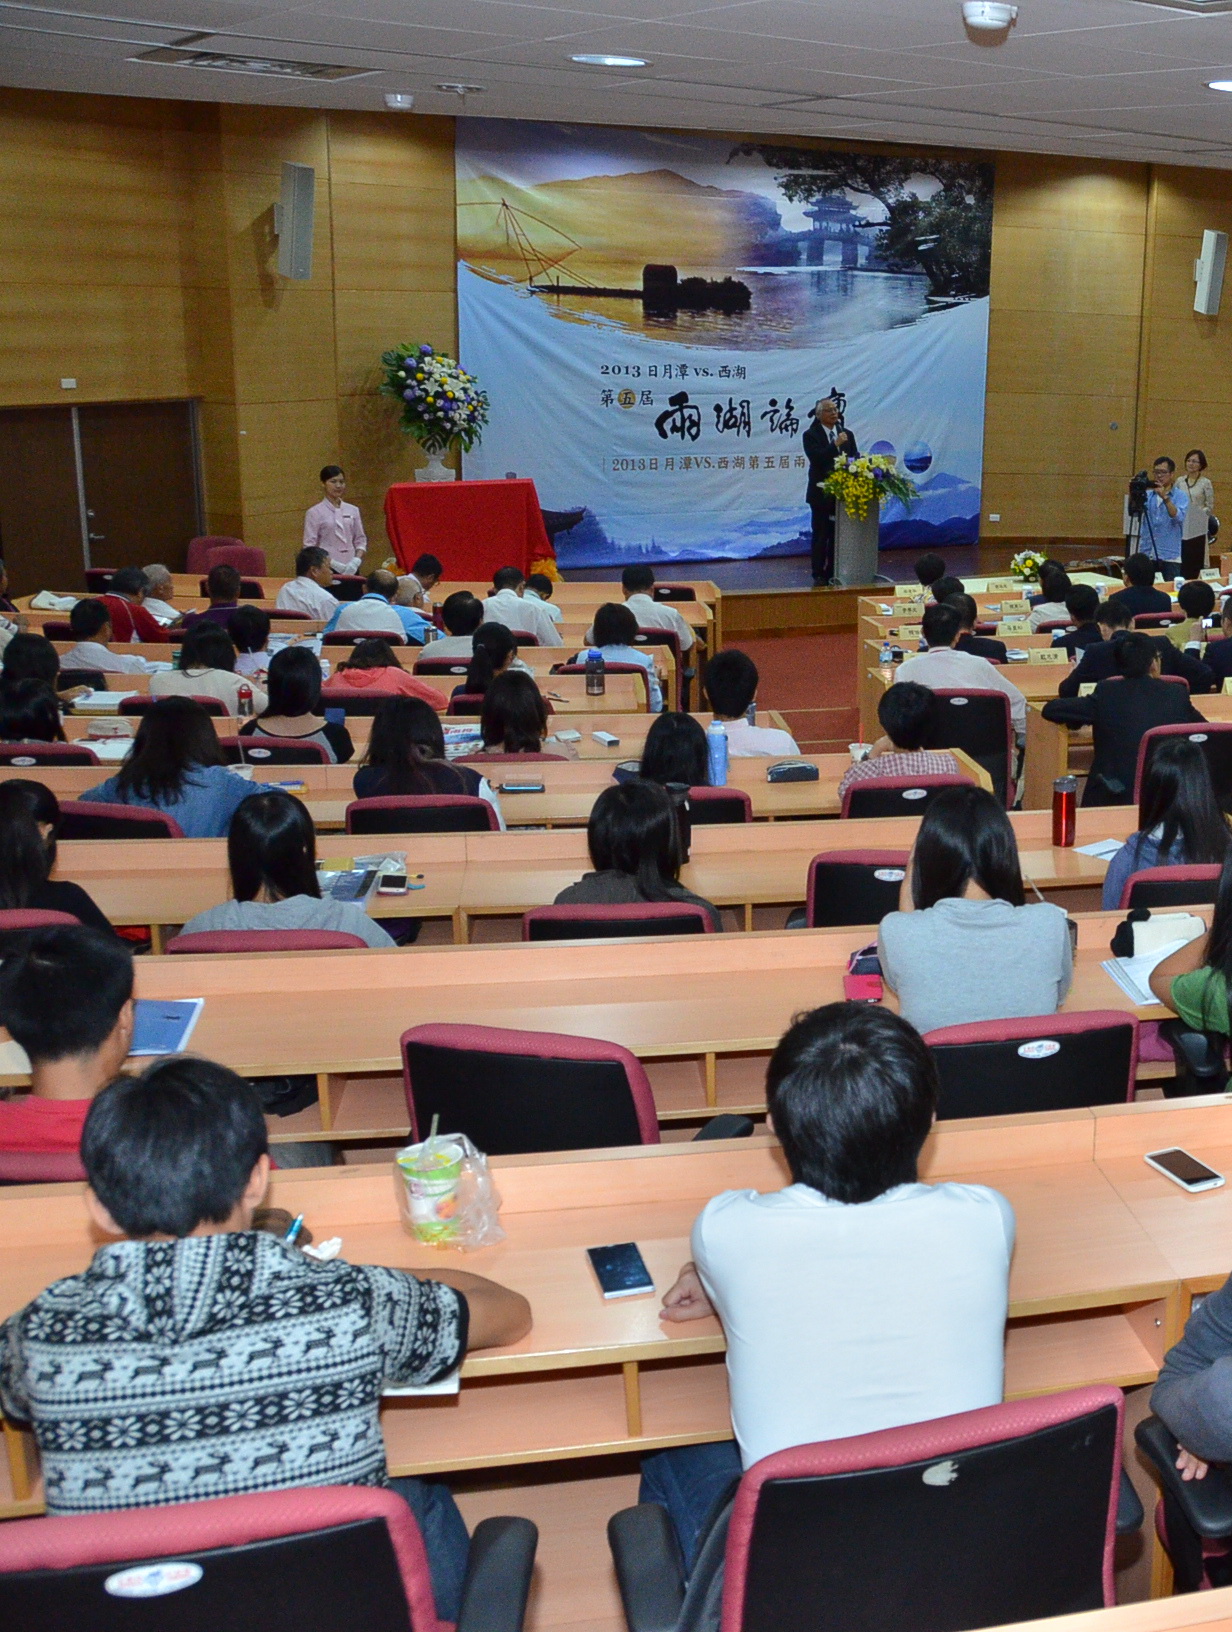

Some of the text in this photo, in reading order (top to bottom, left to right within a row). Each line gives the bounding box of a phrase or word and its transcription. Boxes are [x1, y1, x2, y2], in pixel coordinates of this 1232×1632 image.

[600, 363, 747, 380] 2013 日月潭 vs. 西湖
